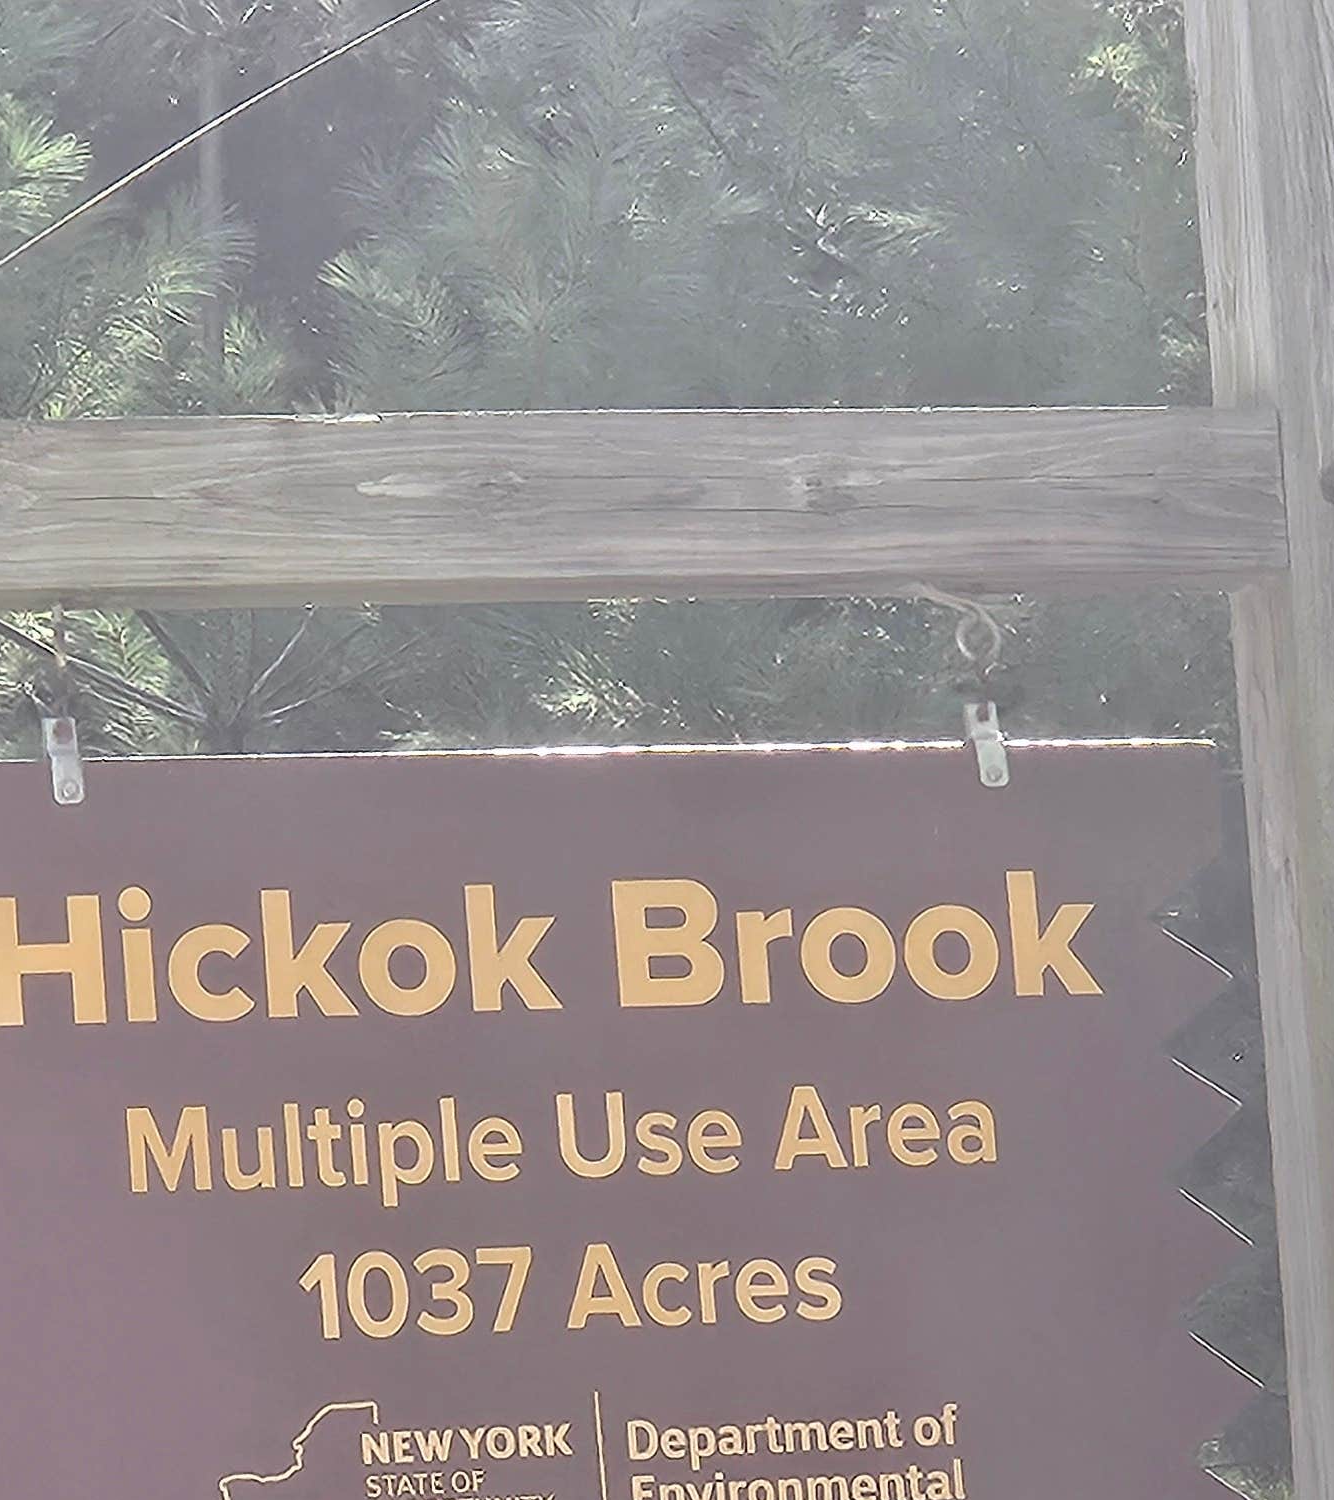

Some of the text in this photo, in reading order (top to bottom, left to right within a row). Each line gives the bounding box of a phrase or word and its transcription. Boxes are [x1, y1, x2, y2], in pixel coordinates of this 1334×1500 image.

[610, 869, 1103, 1008] Brook
[125, 1085, 998, 1211] Multiple Use Area
[299, 1243, 843, 1341] 1037 Acres
[361, 1422, 572, 1466] NEW YORK
[626, 1403, 957, 1471] Department of
[365, 1470, 484, 1499] STATE OF
